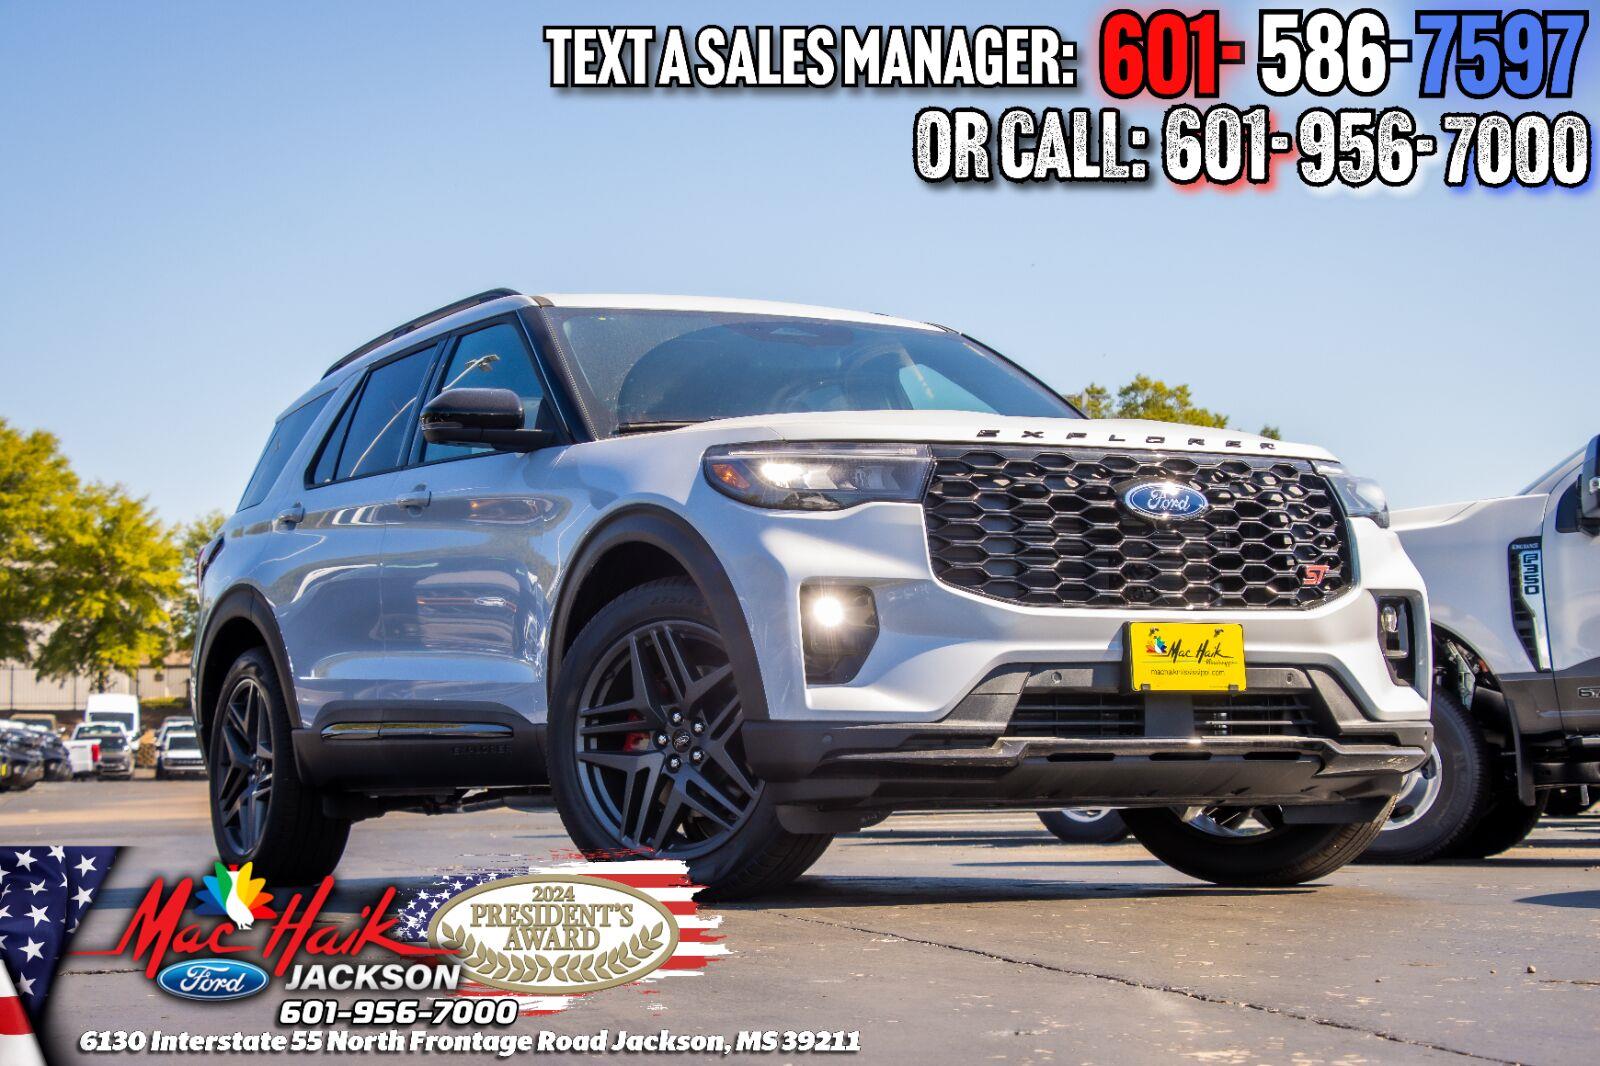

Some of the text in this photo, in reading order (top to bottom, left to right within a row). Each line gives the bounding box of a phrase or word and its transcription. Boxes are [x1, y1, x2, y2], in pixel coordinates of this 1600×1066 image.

[977, 429, 1276, 450] EXPLORER
[1147, 490, 1191, 511] Ford
[1303, 565, 1328, 585] ST
[1166, 639, 1234, 663] Mac Haik
